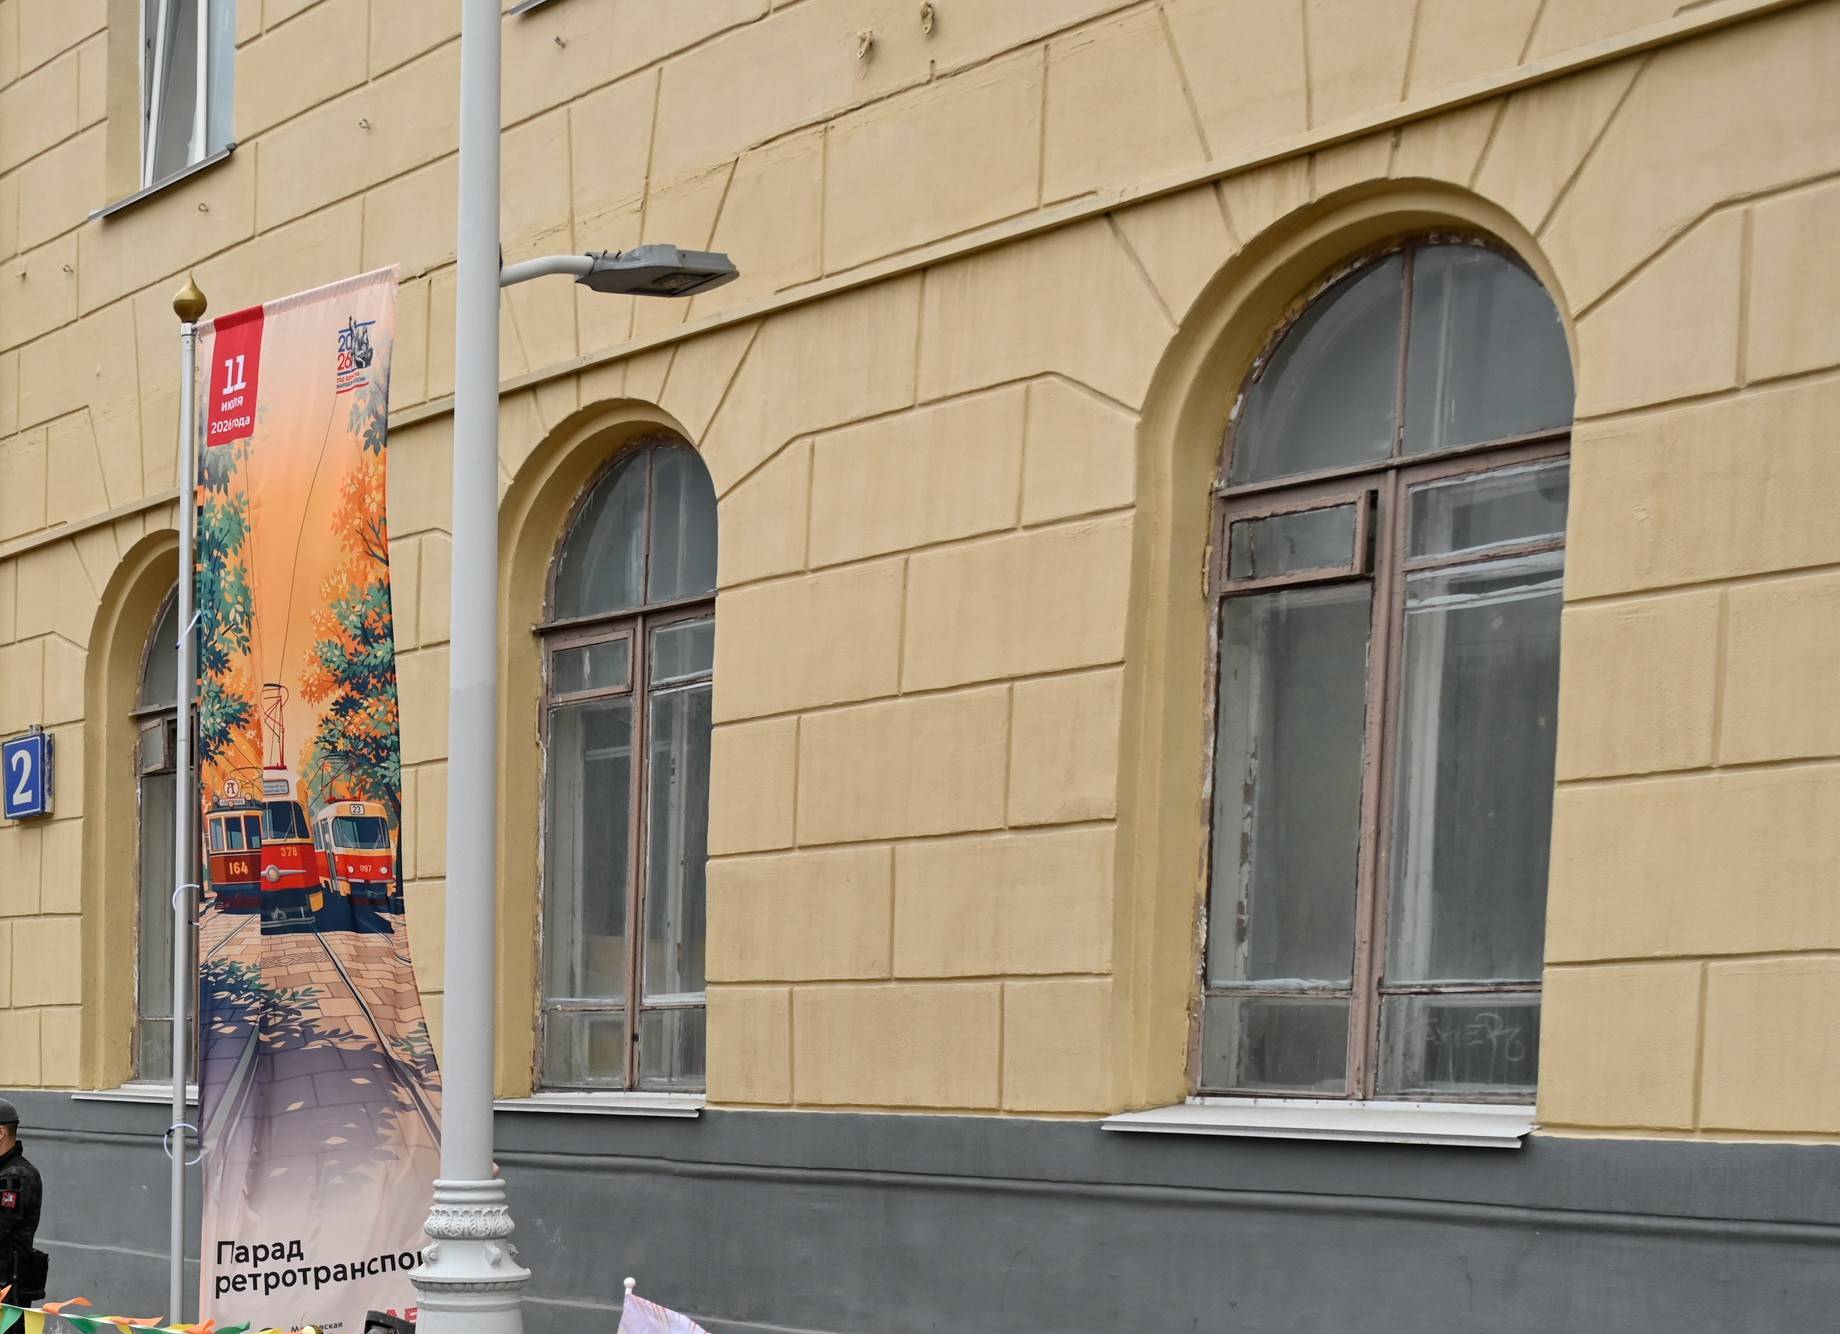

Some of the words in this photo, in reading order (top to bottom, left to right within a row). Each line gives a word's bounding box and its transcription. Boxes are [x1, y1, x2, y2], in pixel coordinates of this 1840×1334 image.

[222, 354, 247, 396] 11
[11, 749, 33, 806] 2
[351, 805, 362, 814] 23
[228, 861, 249, 876] 164
[216, 1239, 304, 1269] Парад
